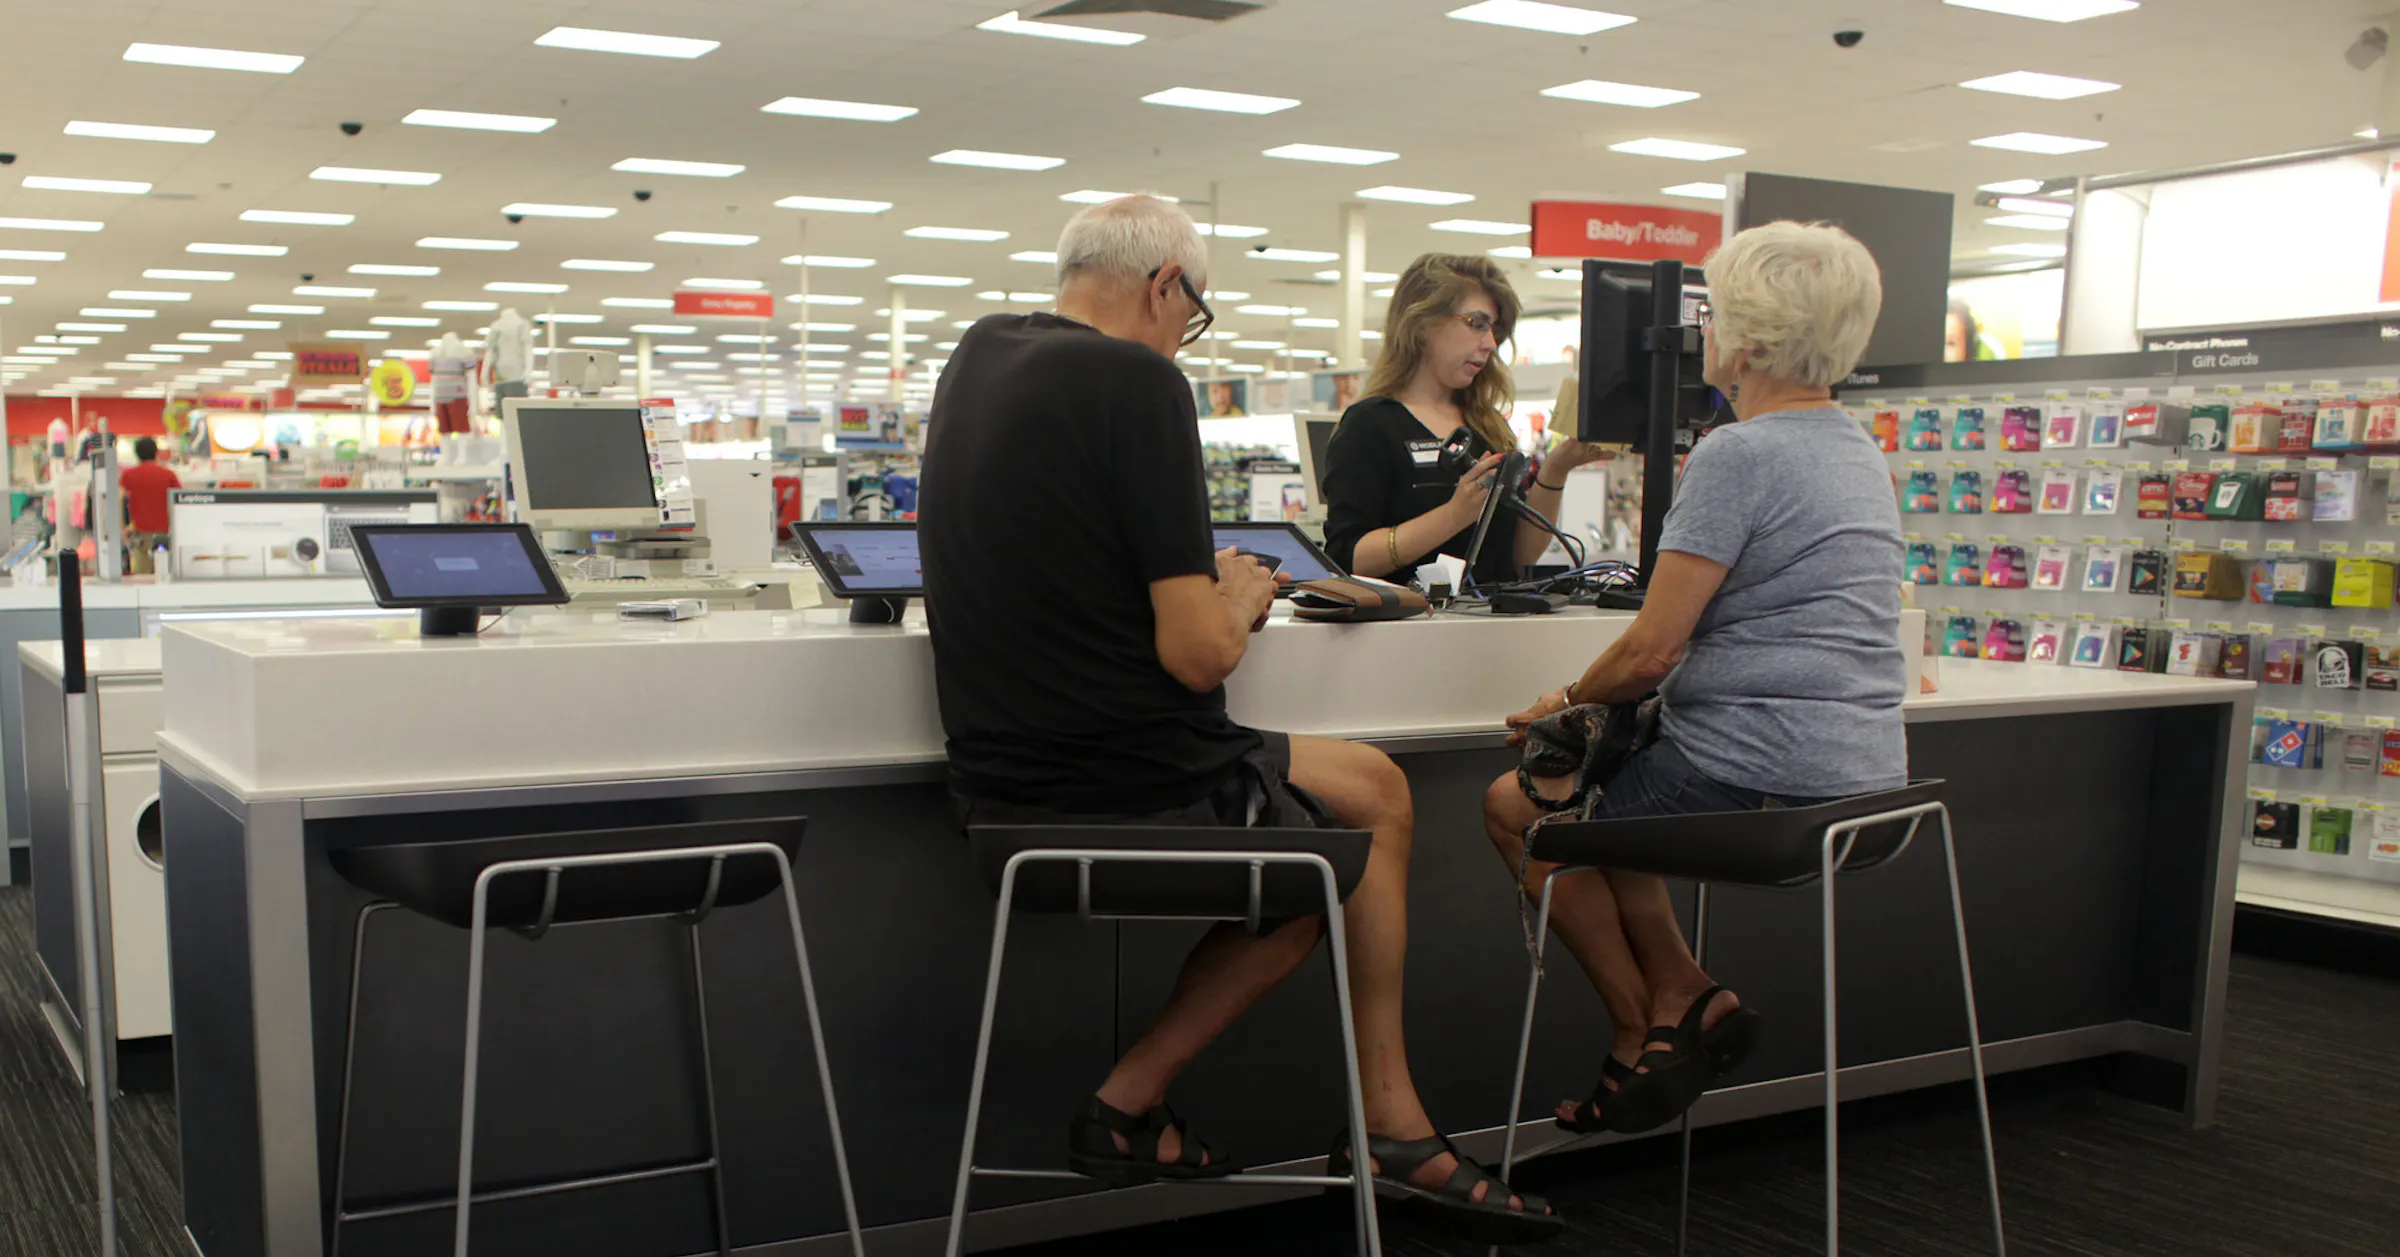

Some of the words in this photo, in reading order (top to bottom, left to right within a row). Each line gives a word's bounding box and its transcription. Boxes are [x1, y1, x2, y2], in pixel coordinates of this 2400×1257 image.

[1586, 218, 1698, 246] Baby/Toddler
[2210, 337, 2249, 349] Phones
[2192, 354, 2216, 369] Gift
[2218, 352, 2259, 368] Cards
[178, 493, 217, 504] Laptops
